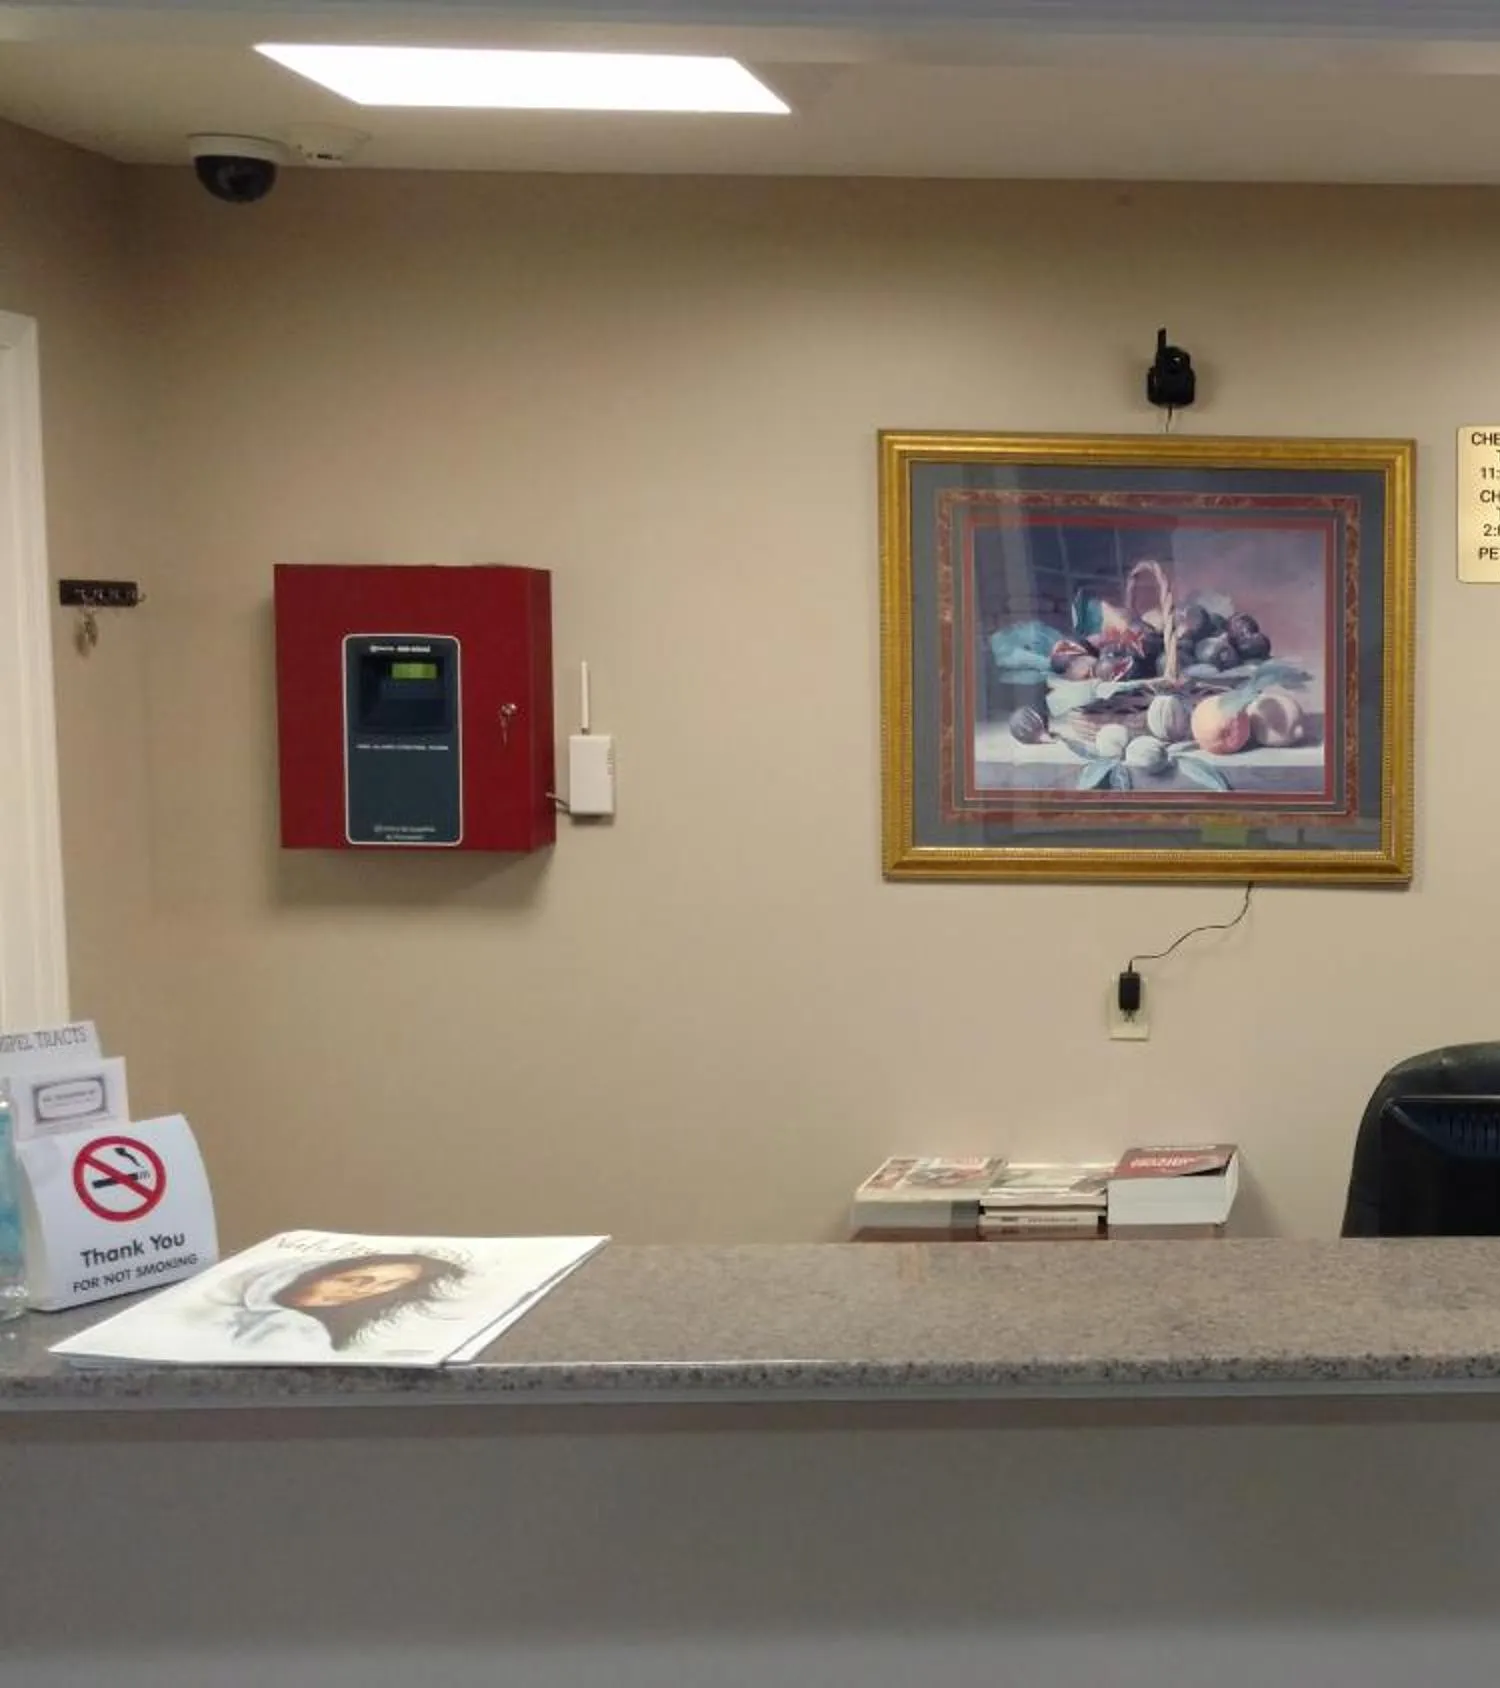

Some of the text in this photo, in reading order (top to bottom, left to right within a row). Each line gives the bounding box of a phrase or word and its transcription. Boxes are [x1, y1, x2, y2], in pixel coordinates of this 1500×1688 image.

[33, 1026, 88, 1049] TRACTS
[80, 1232, 185, 1269] Thank You
[73, 1253, 198, 1293] FOR NOT SMOKING
